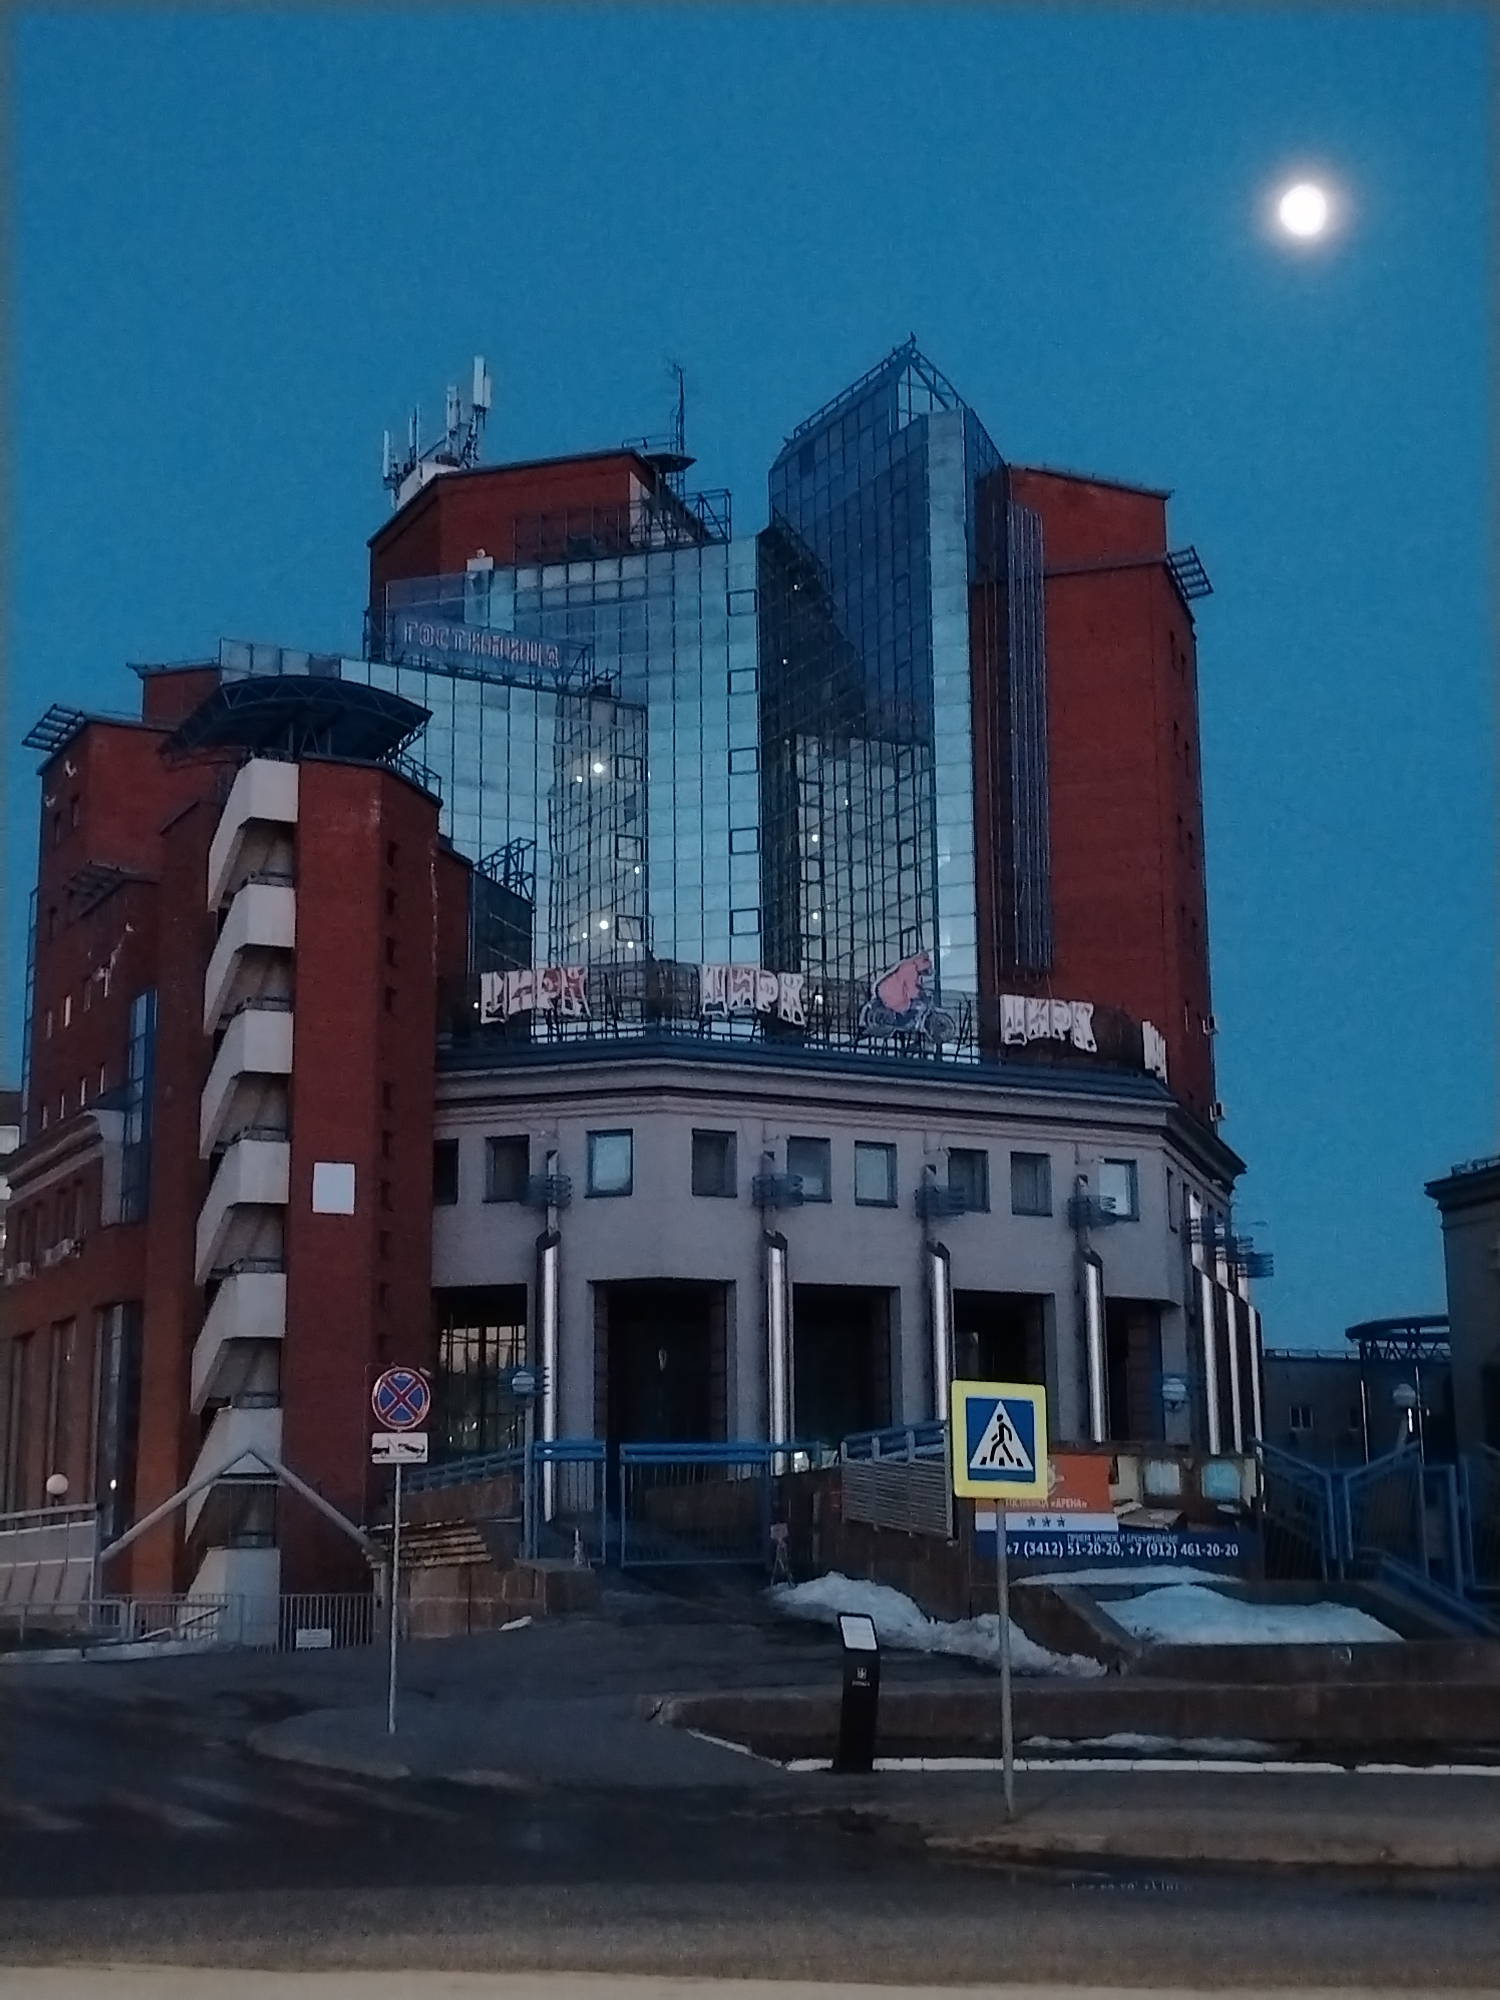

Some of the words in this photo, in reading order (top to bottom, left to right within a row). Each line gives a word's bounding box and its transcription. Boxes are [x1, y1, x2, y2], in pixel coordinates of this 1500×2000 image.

[403, 621, 560, 669] ГОСТИНИЦА
[1000, 994, 1097, 1053] ЦИРК
[1023, 1540, 1064, 1559] (3412)
[1067, 1542, 1124, 1557] 51-20-20,
[1129, 1542, 1142, 1556] +7
[1146, 1541, 1177, 1559] (912)
[1180, 1543, 1239, 1557] 461-20-20
